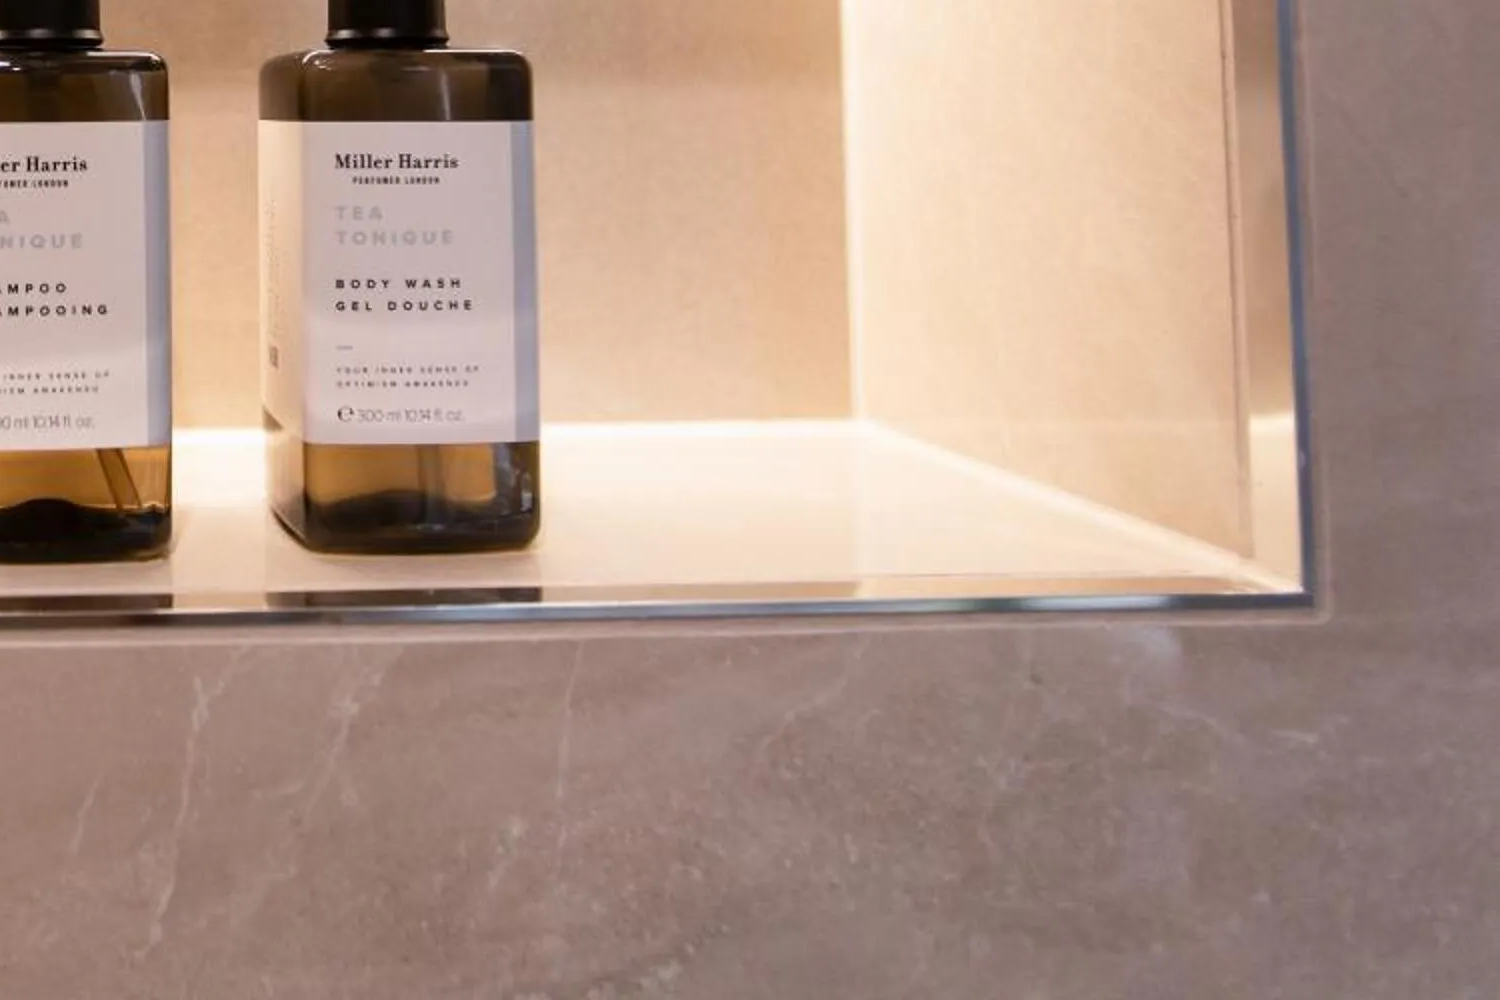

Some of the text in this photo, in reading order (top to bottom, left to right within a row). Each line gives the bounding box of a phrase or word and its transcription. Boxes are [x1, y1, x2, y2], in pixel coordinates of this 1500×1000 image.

[26, 156, 87, 172] Harris
[334, 153, 460, 169] Miller Harris
[335, 205, 383, 221] TEA
[335, 229, 453, 246] TONIQUE
[335, 278, 461, 289] BODY WASH
[335, 300, 472, 311] GEL DOUCHE
[357, 408, 384, 422] 300
